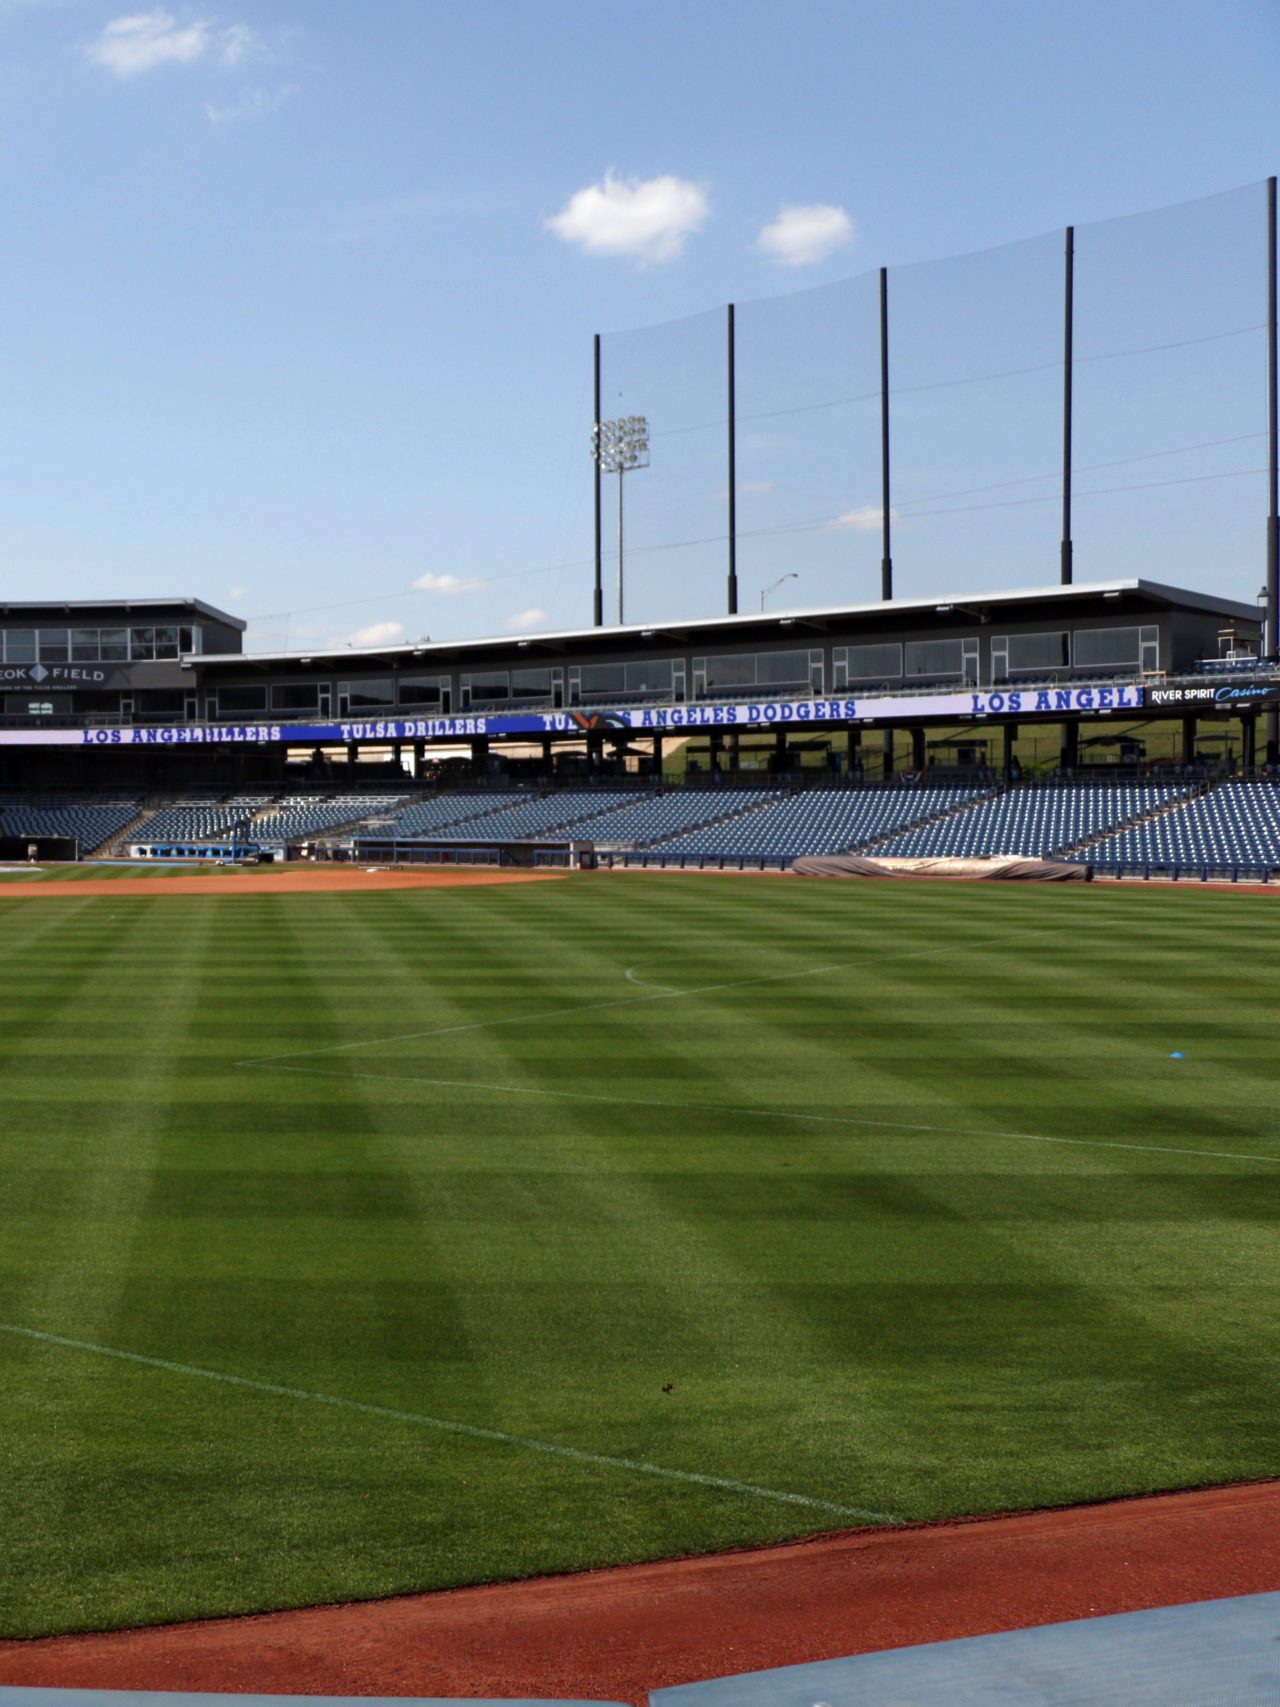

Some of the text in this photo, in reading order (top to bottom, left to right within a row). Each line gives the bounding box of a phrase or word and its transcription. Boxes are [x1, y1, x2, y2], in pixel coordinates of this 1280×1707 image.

[53, 668, 105, 682] FIELD
[972, 691, 1022, 713] LOS
[1152, 685, 1276, 704] RIVER SPIRIT Casino
[642, 706, 737, 727] ANGELES
[748, 700, 856, 722] DODGERS
[83, 729, 121, 744] LOS
[341, 718, 487, 739] TULSA DRILLERS
